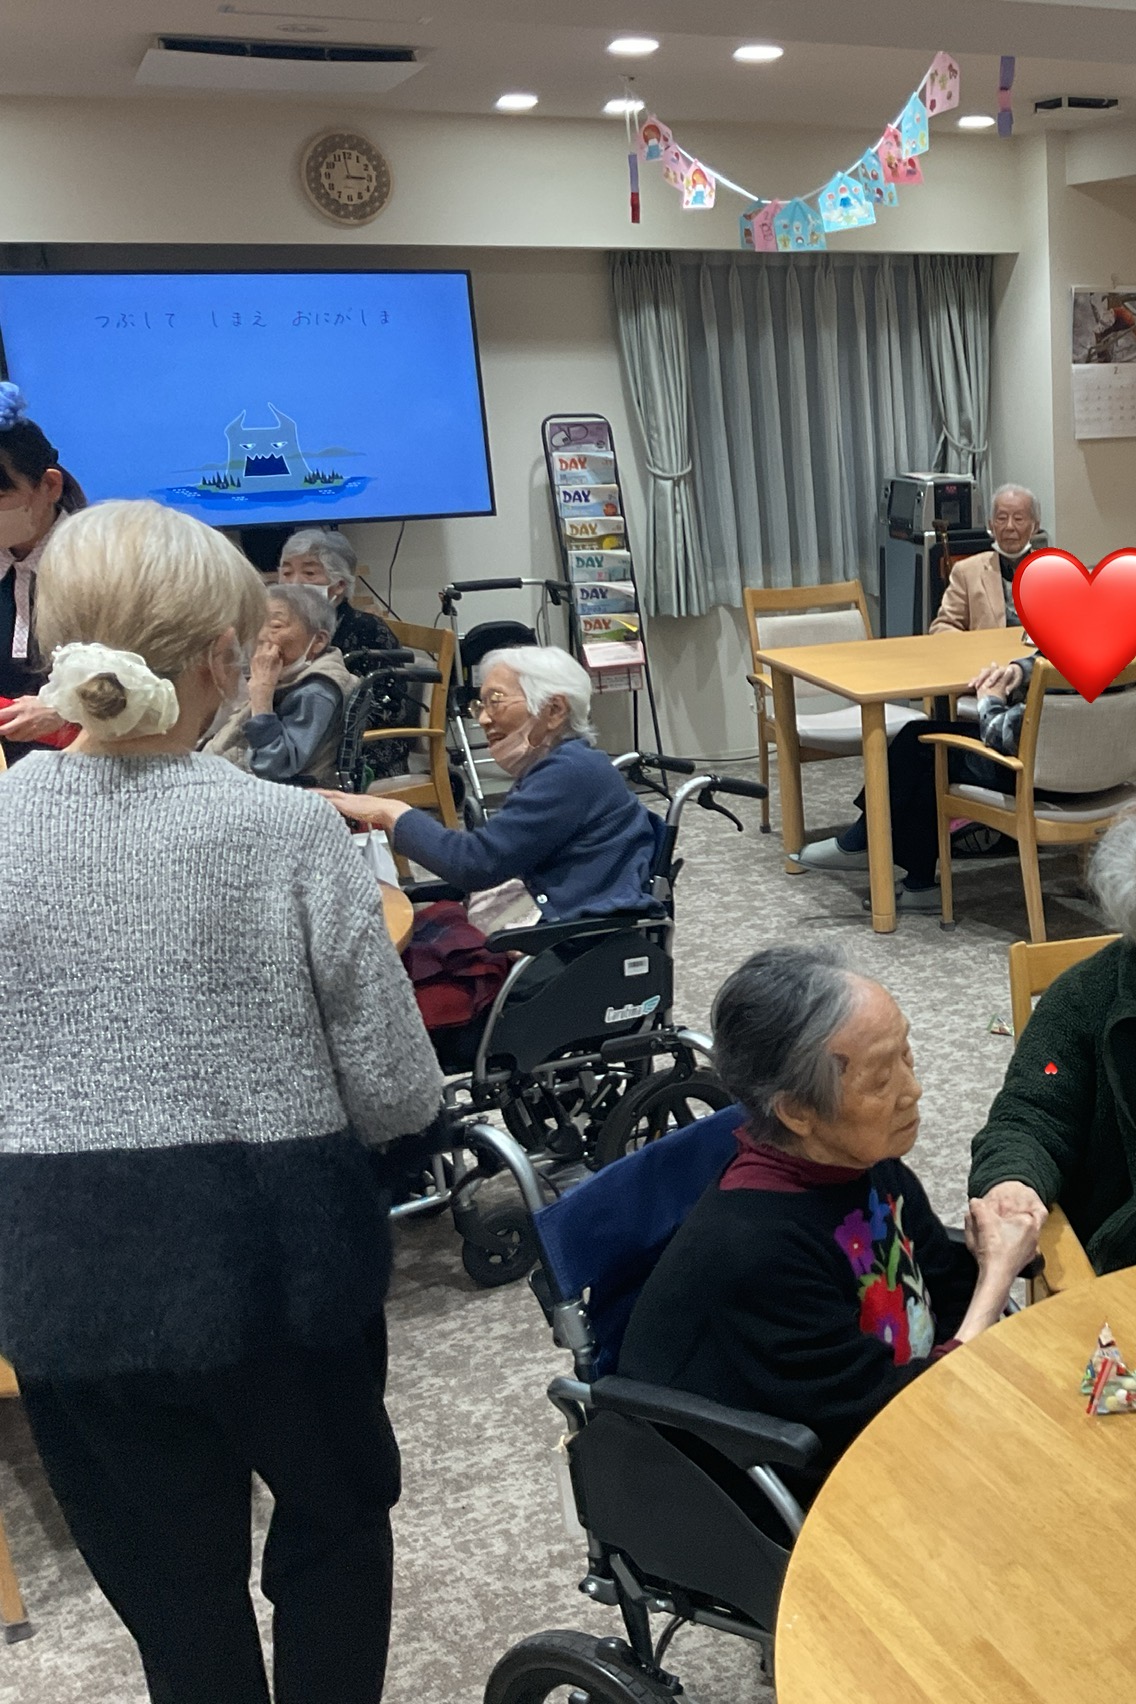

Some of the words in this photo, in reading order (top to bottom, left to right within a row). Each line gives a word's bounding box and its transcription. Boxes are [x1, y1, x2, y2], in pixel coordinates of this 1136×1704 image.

[94, 310, 176, 329] つぶして
[211, 310, 268, 328] しまえ
[291, 308, 391, 327] おにがしま
[559, 457, 587, 471] DAY
[562, 490, 591, 503] DAY
[569, 523, 598, 536] DAY
[575, 556, 604, 568] DAY
[580, 588, 608, 600] DAY
[583, 618, 612, 632] DAY
